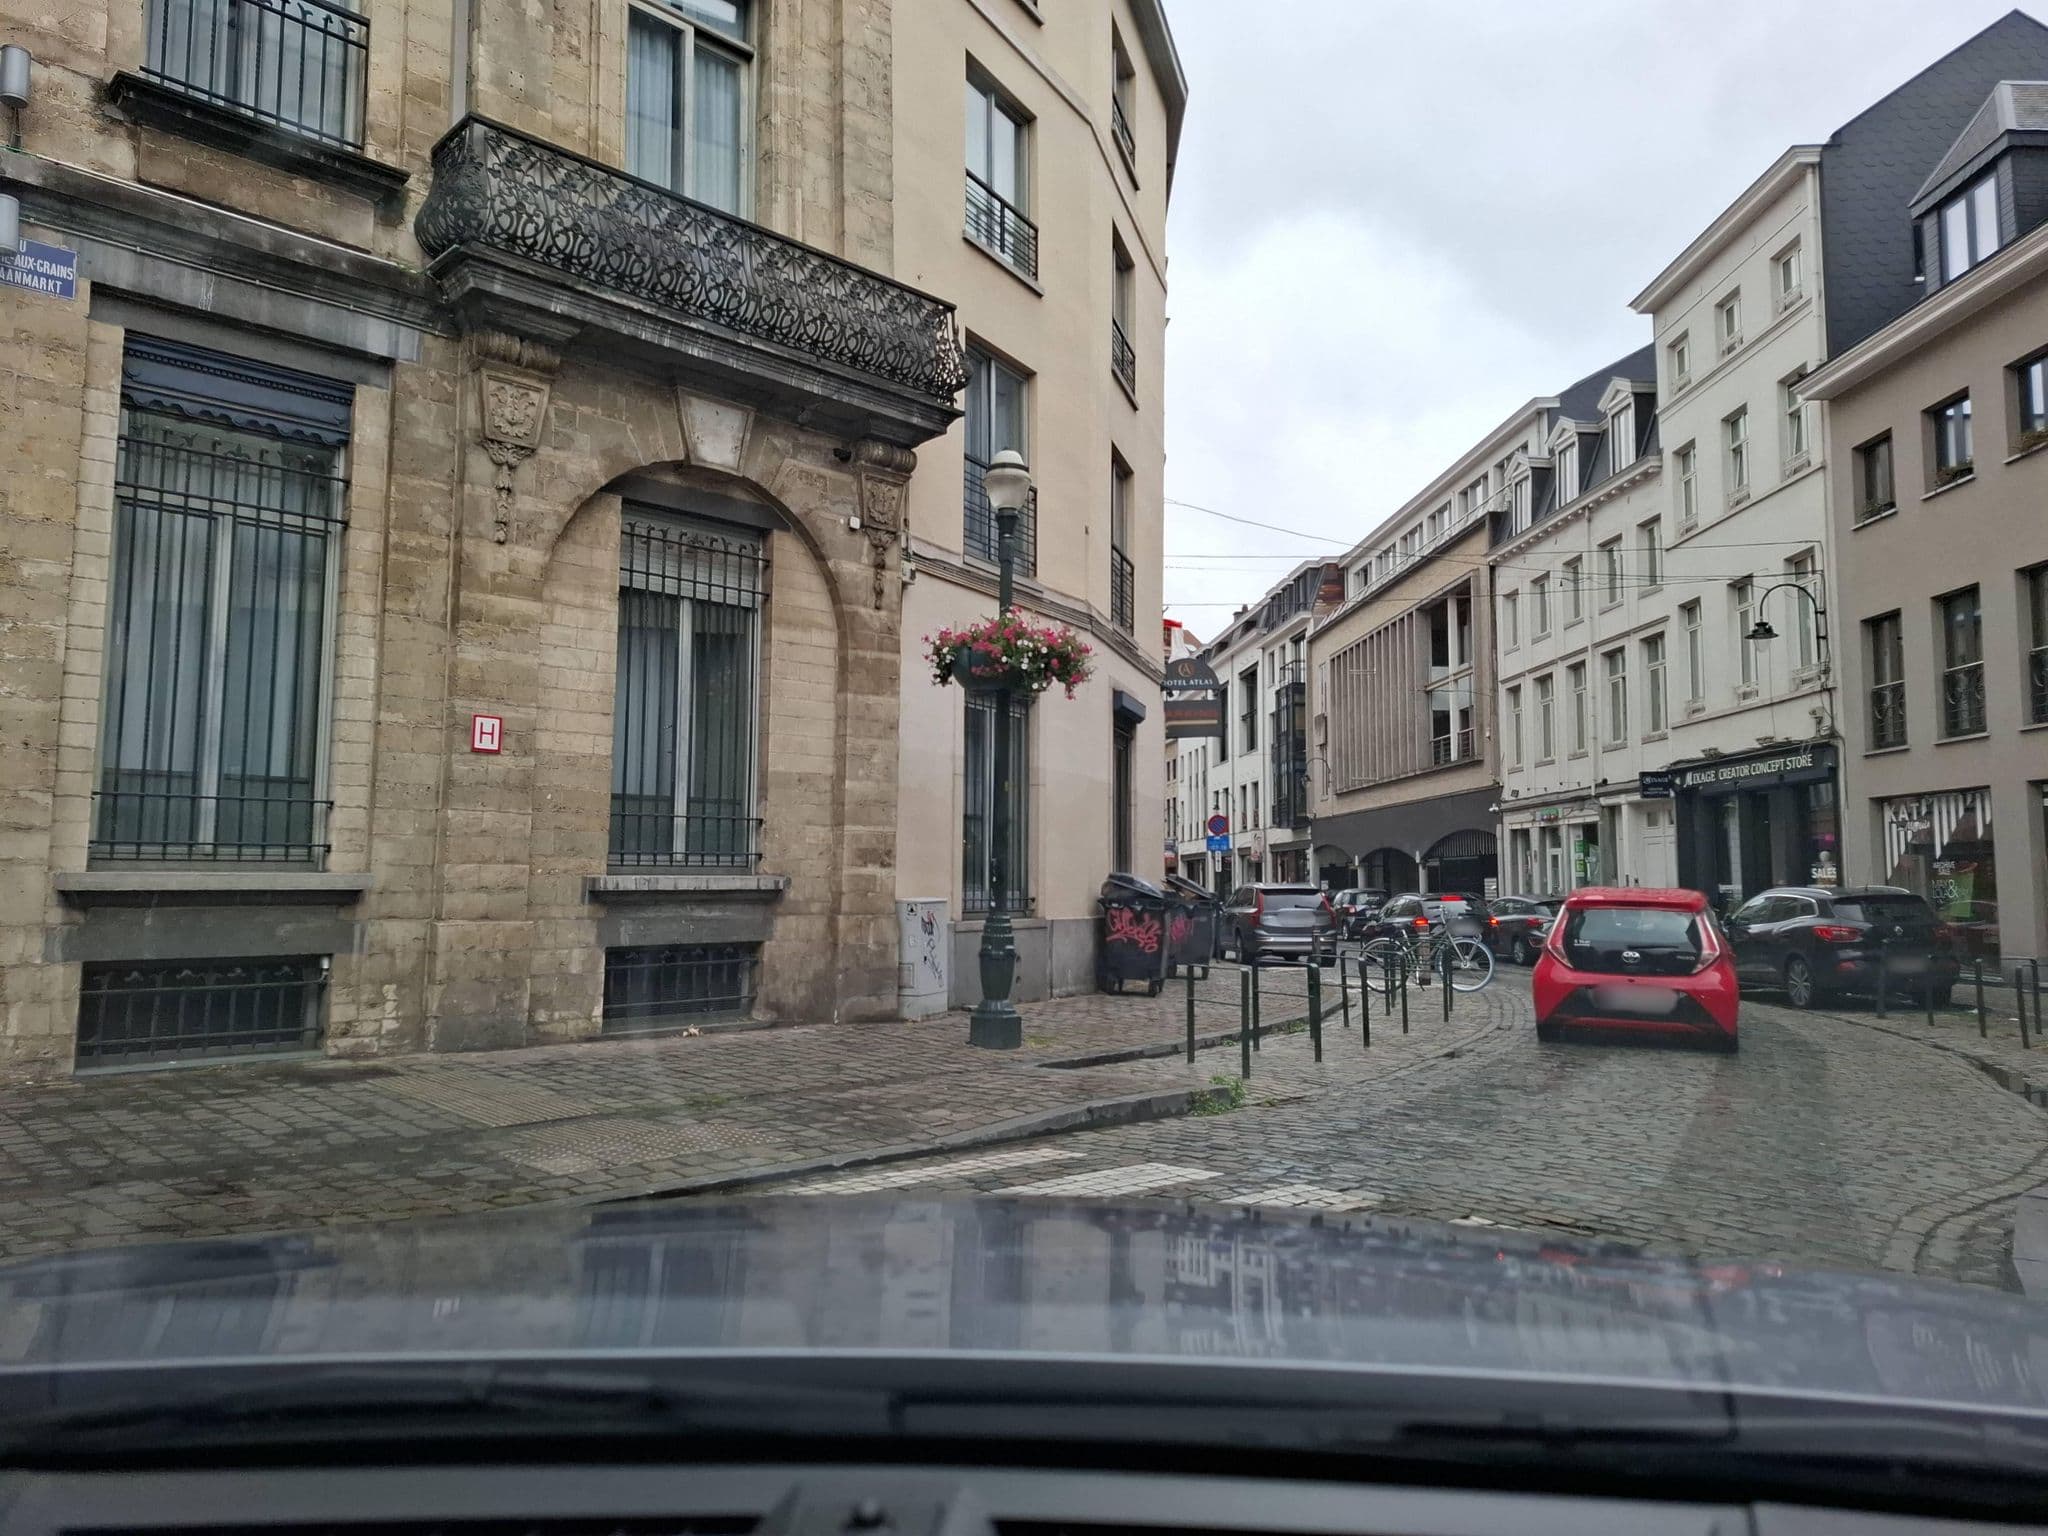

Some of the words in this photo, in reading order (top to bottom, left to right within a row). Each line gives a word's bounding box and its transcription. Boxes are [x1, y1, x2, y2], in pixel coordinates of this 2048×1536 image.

[479, 722, 495, 744] H
[1718, 765, 1750, 780] CREATOR
[1751, 759, 1785, 775] CONCEPT
[1786, 754, 1814, 770] STORE
[1811, 867, 1837, 879] SALES
